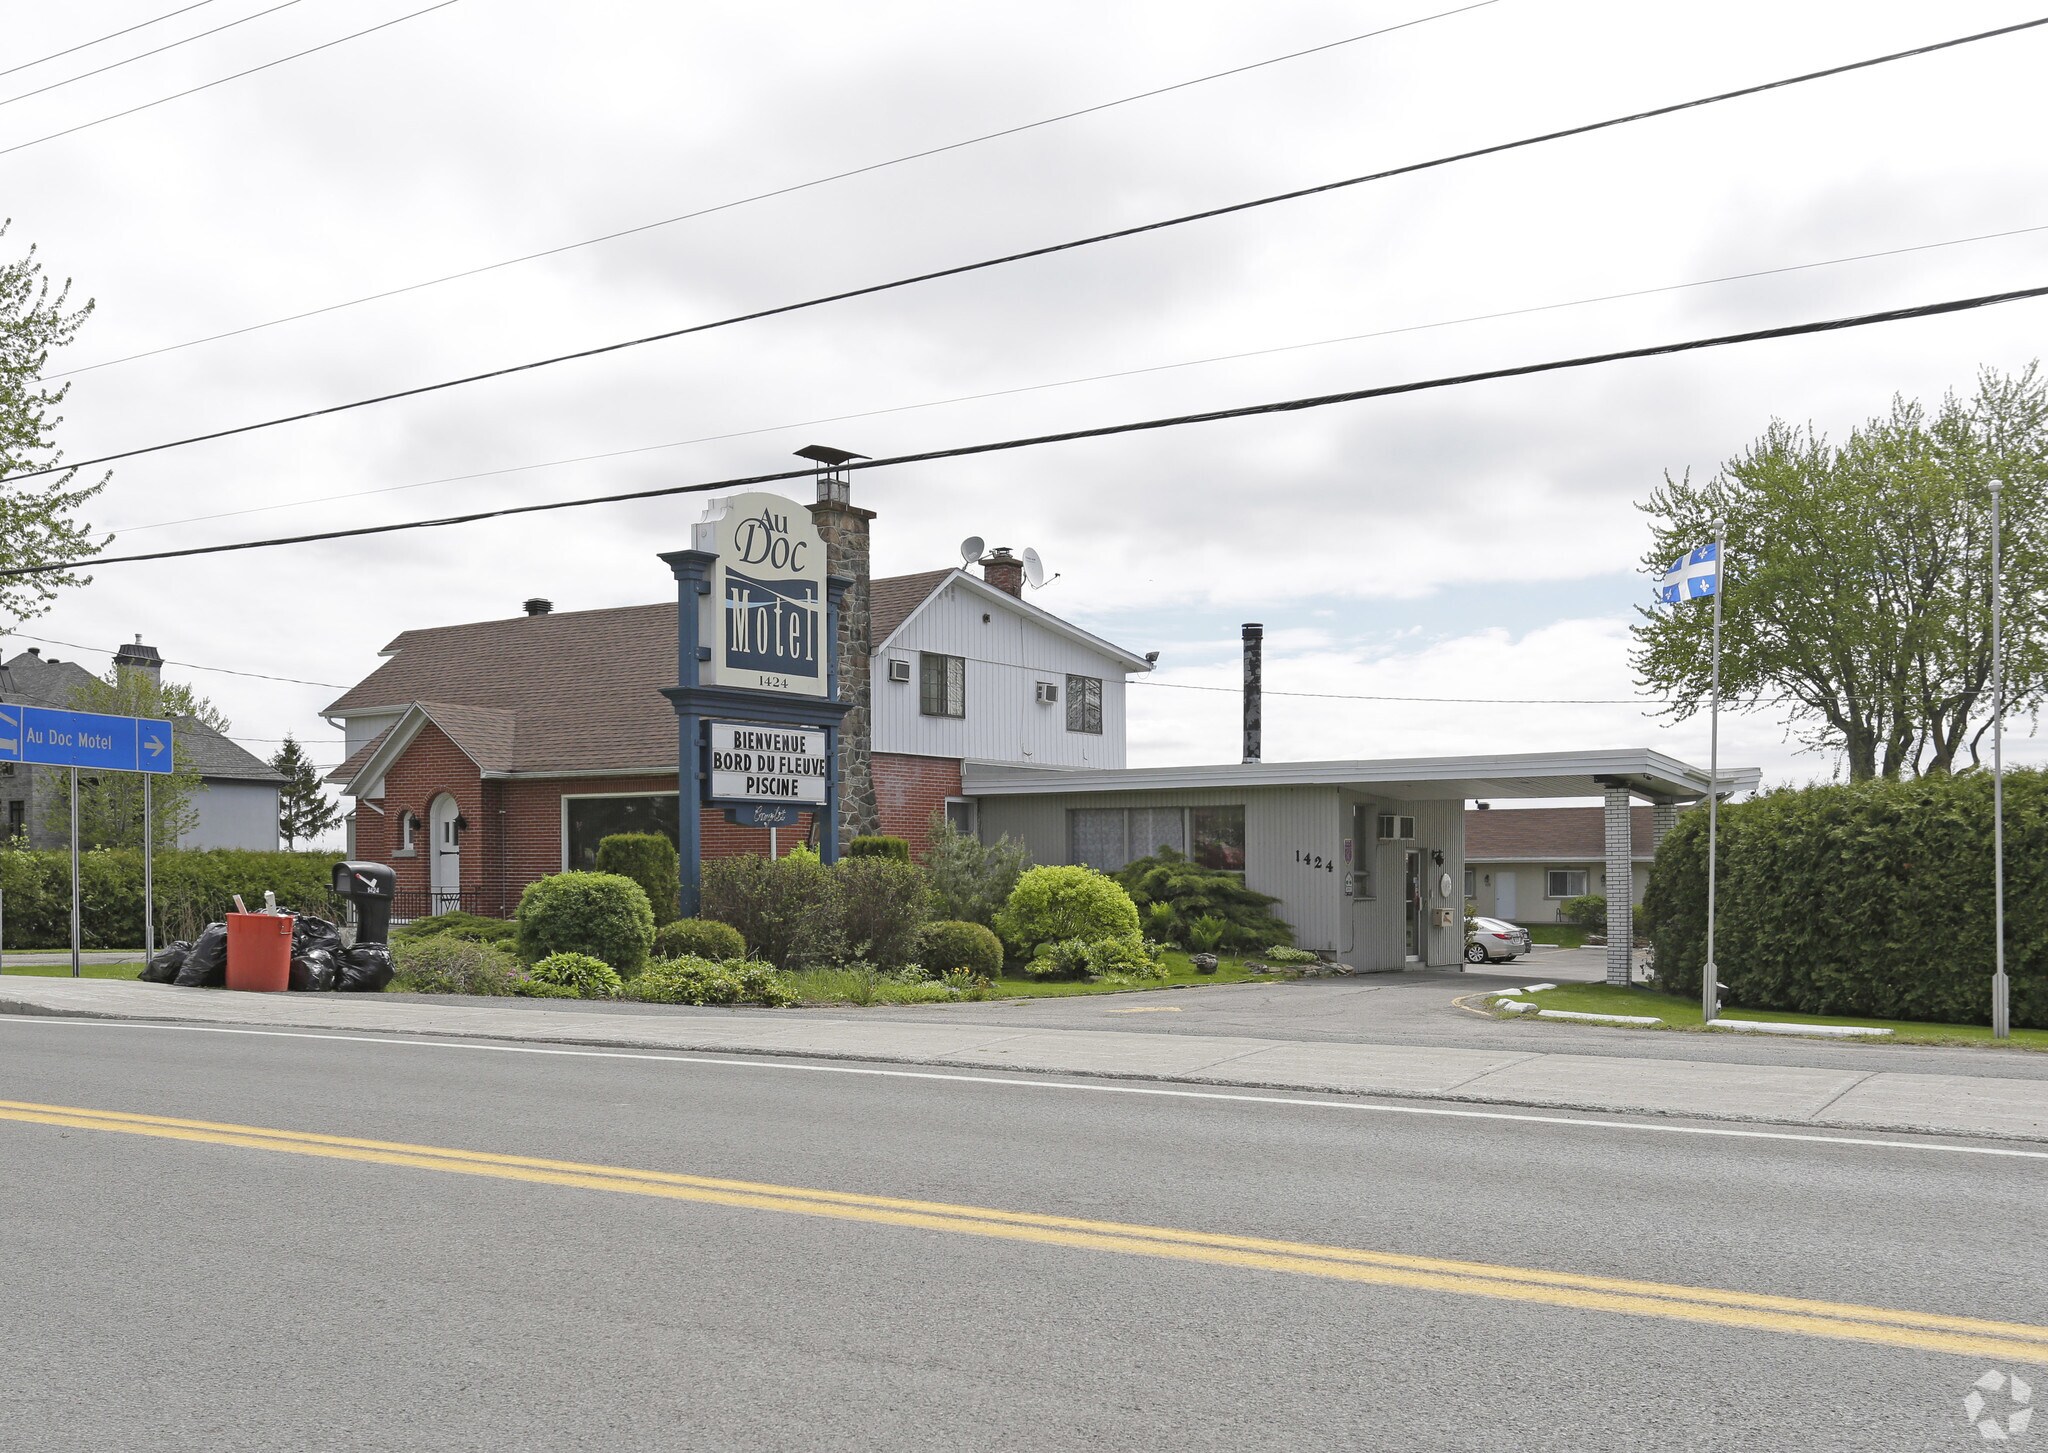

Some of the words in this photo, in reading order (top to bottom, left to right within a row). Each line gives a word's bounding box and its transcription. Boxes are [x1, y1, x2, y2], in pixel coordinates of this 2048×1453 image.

[758, 507, 788, 534] Au
[731, 587, 813, 660] Motel
[760, 675, 788, 688] 1424
[27, 727, 43, 743] Au
[49, 729, 72, 746] Doc
[79, 732, 112, 749] Motel
[734, 731, 805, 753] BIENVENUE
[714, 752, 751, 771] BORD
[758, 755, 774, 772] DU
[780, 757, 824, 775] FLEUVE
[747, 777, 798, 795] PISCINE
[1296, 850, 1333, 872] 1424
